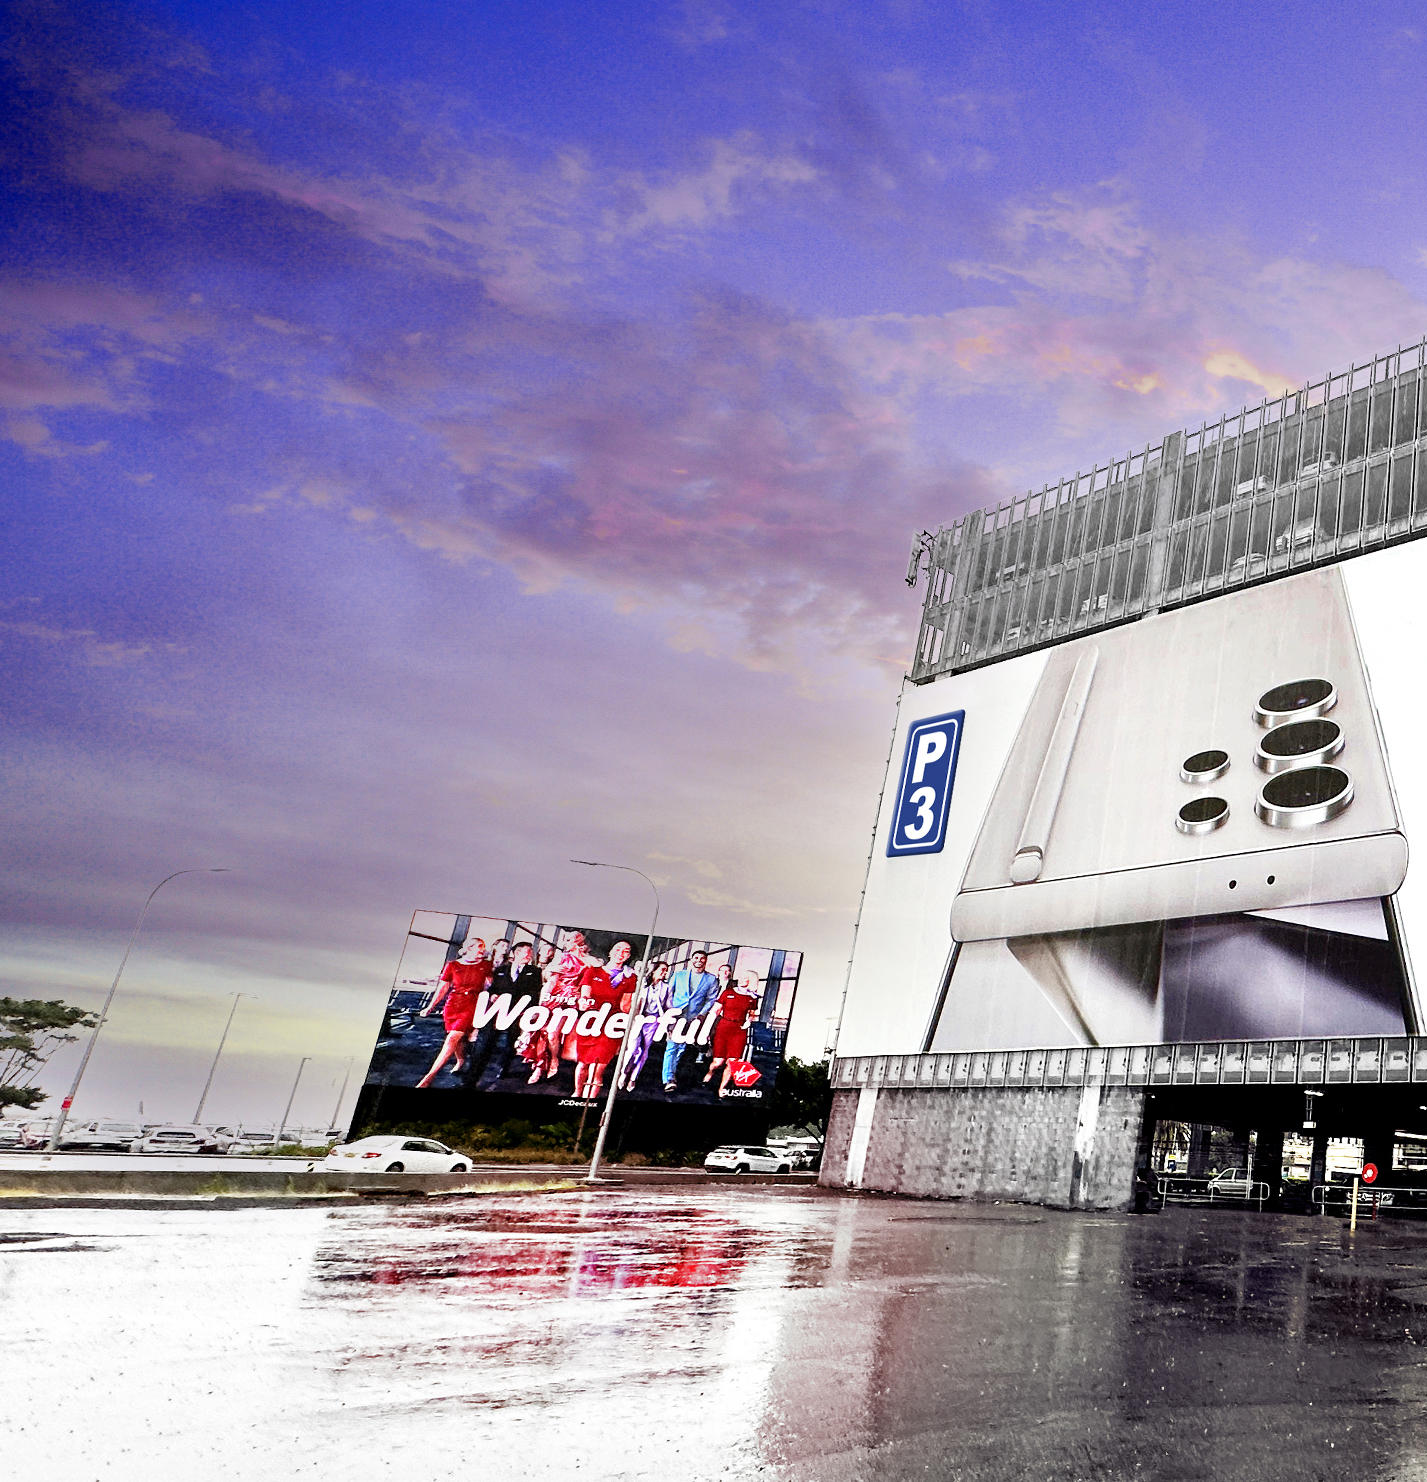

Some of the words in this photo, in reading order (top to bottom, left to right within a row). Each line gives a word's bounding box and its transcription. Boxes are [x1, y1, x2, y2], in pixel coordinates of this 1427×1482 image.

[911, 731, 947, 784] P
[904, 786, 936, 840] 3
[472, 990, 718, 1045] Wonderful
